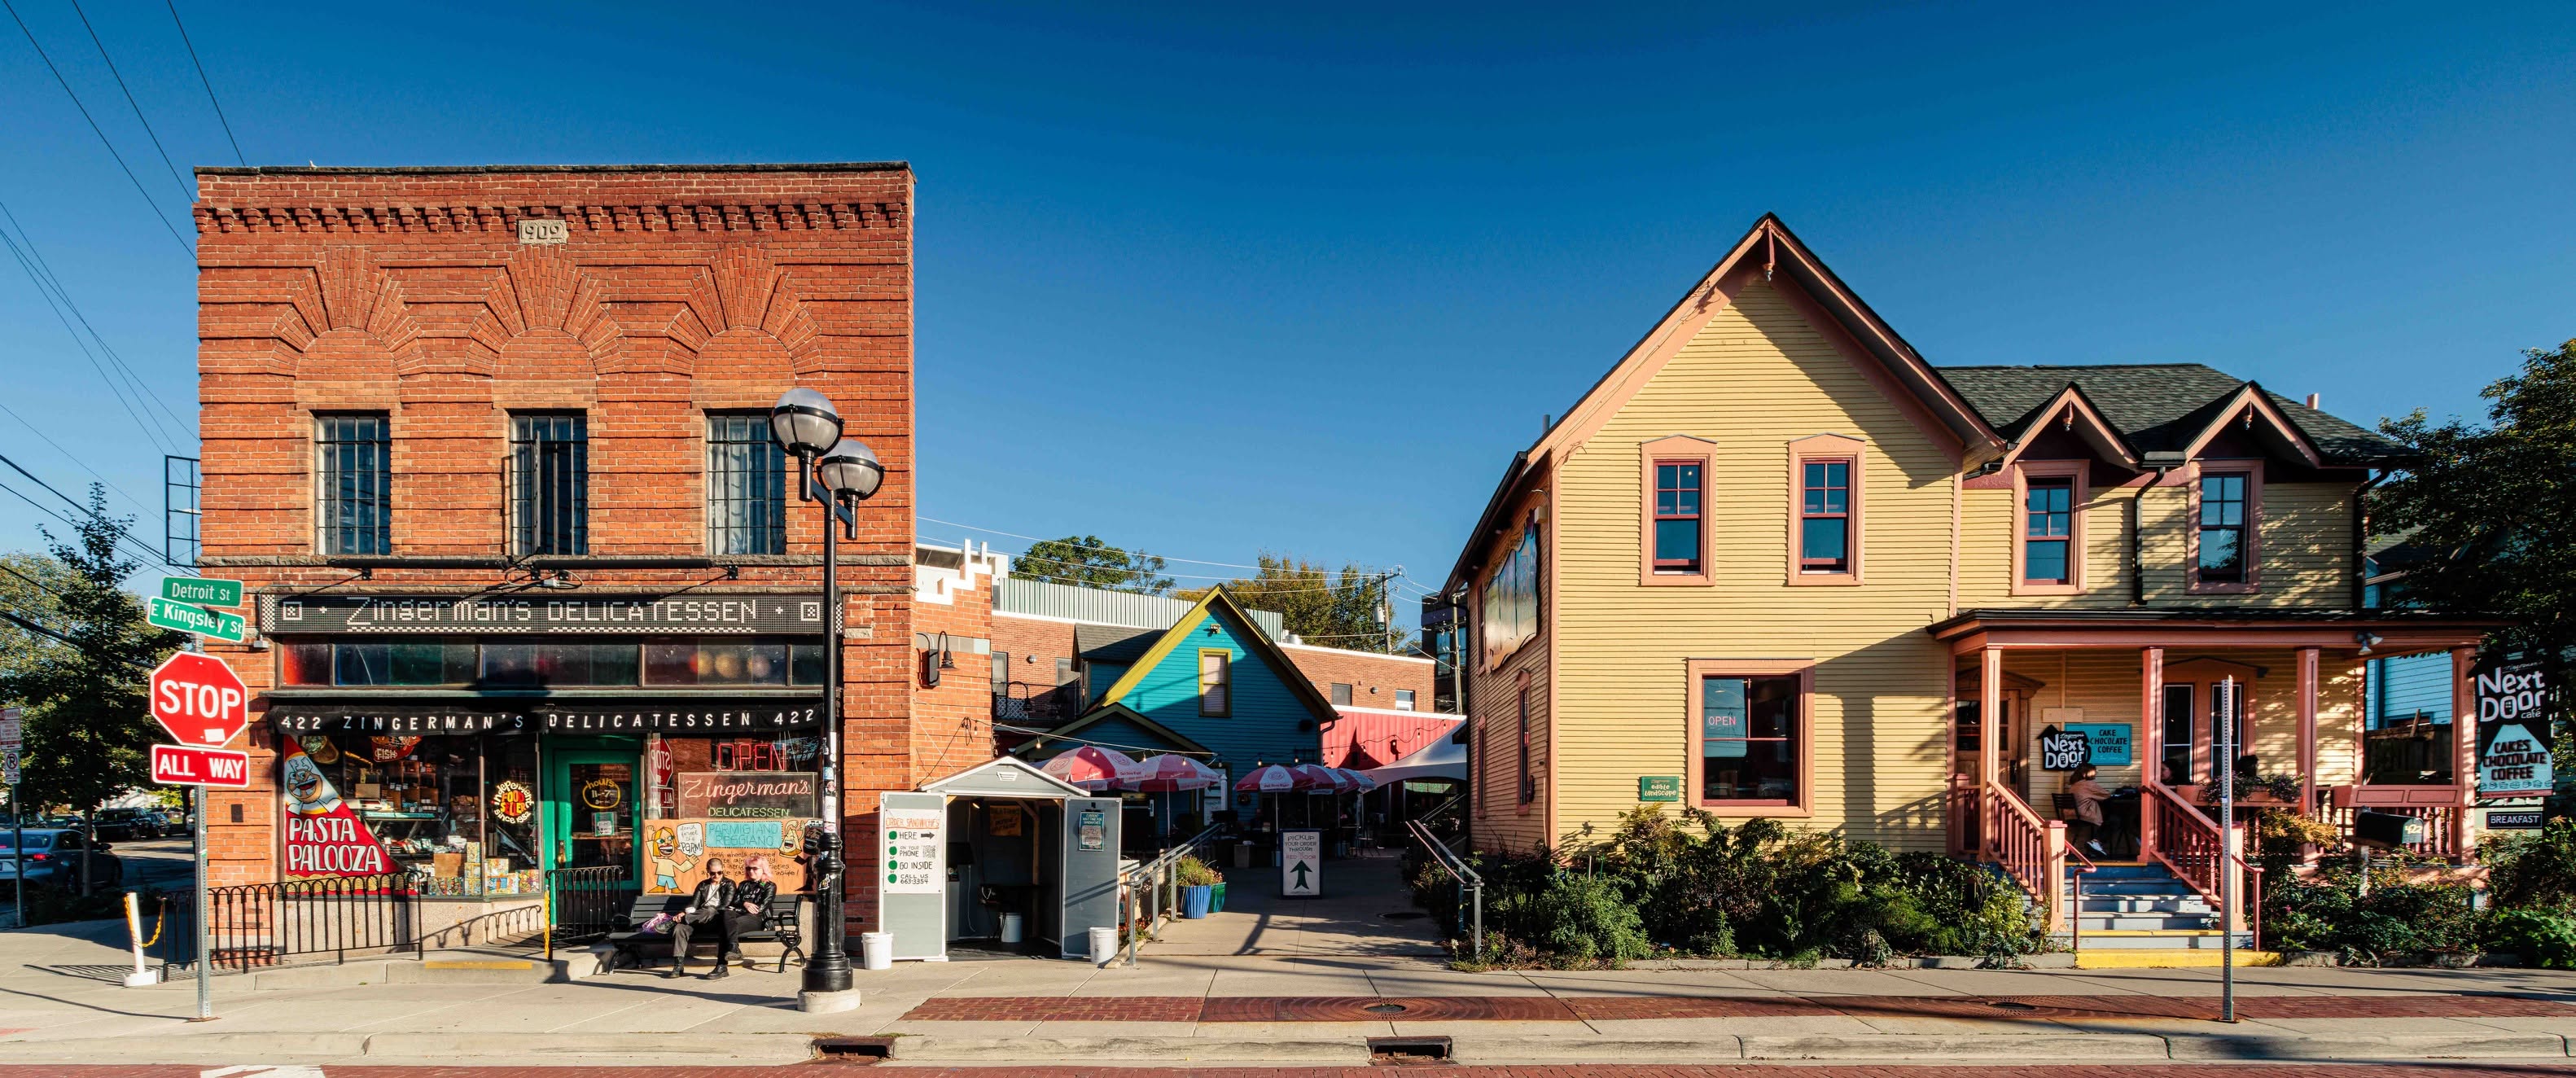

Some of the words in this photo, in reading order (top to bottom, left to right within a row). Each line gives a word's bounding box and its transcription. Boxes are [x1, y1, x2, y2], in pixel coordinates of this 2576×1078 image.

[172, 582, 214, 601] Detroit
[220, 588, 230, 601] St
[346, 596, 532, 625] Zingerman's
[548, 599, 756, 624] DELICATESSEN
[151, 603, 159, 617] E
[164, 603, 225, 634] Kingsley
[230, 620, 243, 635] St
[2477, 666, 2546, 697] Next
[159, 679, 241, 720] STOP
[2479, 690, 2547, 722] Door
[281, 716, 321, 730] 422
[343, 713, 524, 730] ZINGERMAN'S
[549, 712, 750, 729] DELICATESSEN
[774, 708, 814, 725] 422
[1708, 716, 1736, 725] OPEN
[2521, 708, 2541, 719] café
[2044, 734, 2084, 752] Next
[2494, 739, 2532, 754] CAKES
[376, 747, 396, 760] FISH
[717, 743, 786, 772] OPEN
[2045, 751, 2084, 769] Door
[2483, 752, 2548, 768] CHOCOLATE
[158, 754, 196, 777] ALL
[208, 756, 244, 779] WAY
[2491, 765, 2534, 782] COFFEE
[586, 778, 615, 789] hours
[685, 779, 812, 804] Zingerman's
[502, 790, 525, 803] FOOD
[493, 808, 516, 824] since
[500, 801, 528, 816] SELLER
[708, 806, 790, 817] DELICATESSEN
[907, 817, 940, 827] SANDWICHES
[2490, 815, 2540, 824] BREAKFAST
[289, 817, 357, 844] PASTA
[708, 823, 778, 834] PARMIGIANO
[899, 831, 917, 840] HERE
[2404, 824, 2423, 835] 422
[716, 835, 773, 846] REGGIANO
[288, 844, 383, 872] PALOOZA
[900, 861, 909, 870] GO
[911, 861, 933, 870] INSIDE
